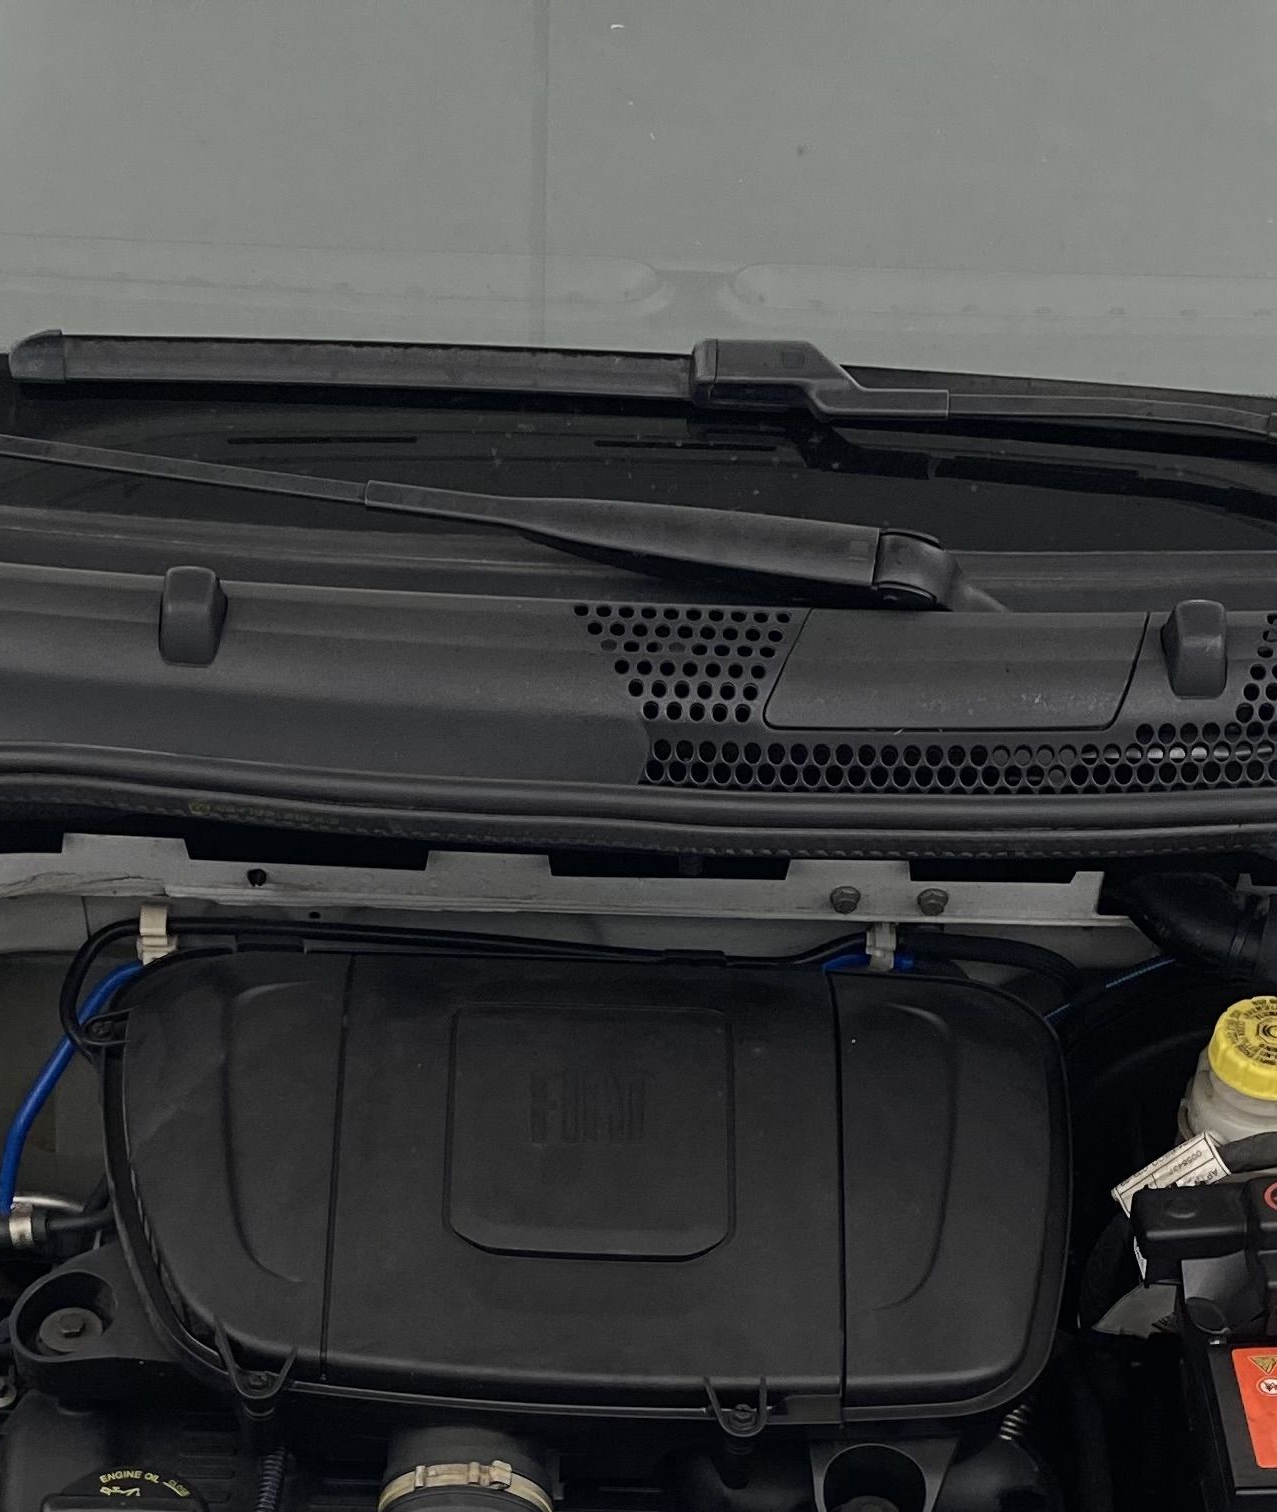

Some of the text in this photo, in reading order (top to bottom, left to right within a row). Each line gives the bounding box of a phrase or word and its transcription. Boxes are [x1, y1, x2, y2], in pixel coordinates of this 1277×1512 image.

[530, 1070, 656, 1145] FIAT
[99, 1470, 160, 1484] ENGINE OIL
